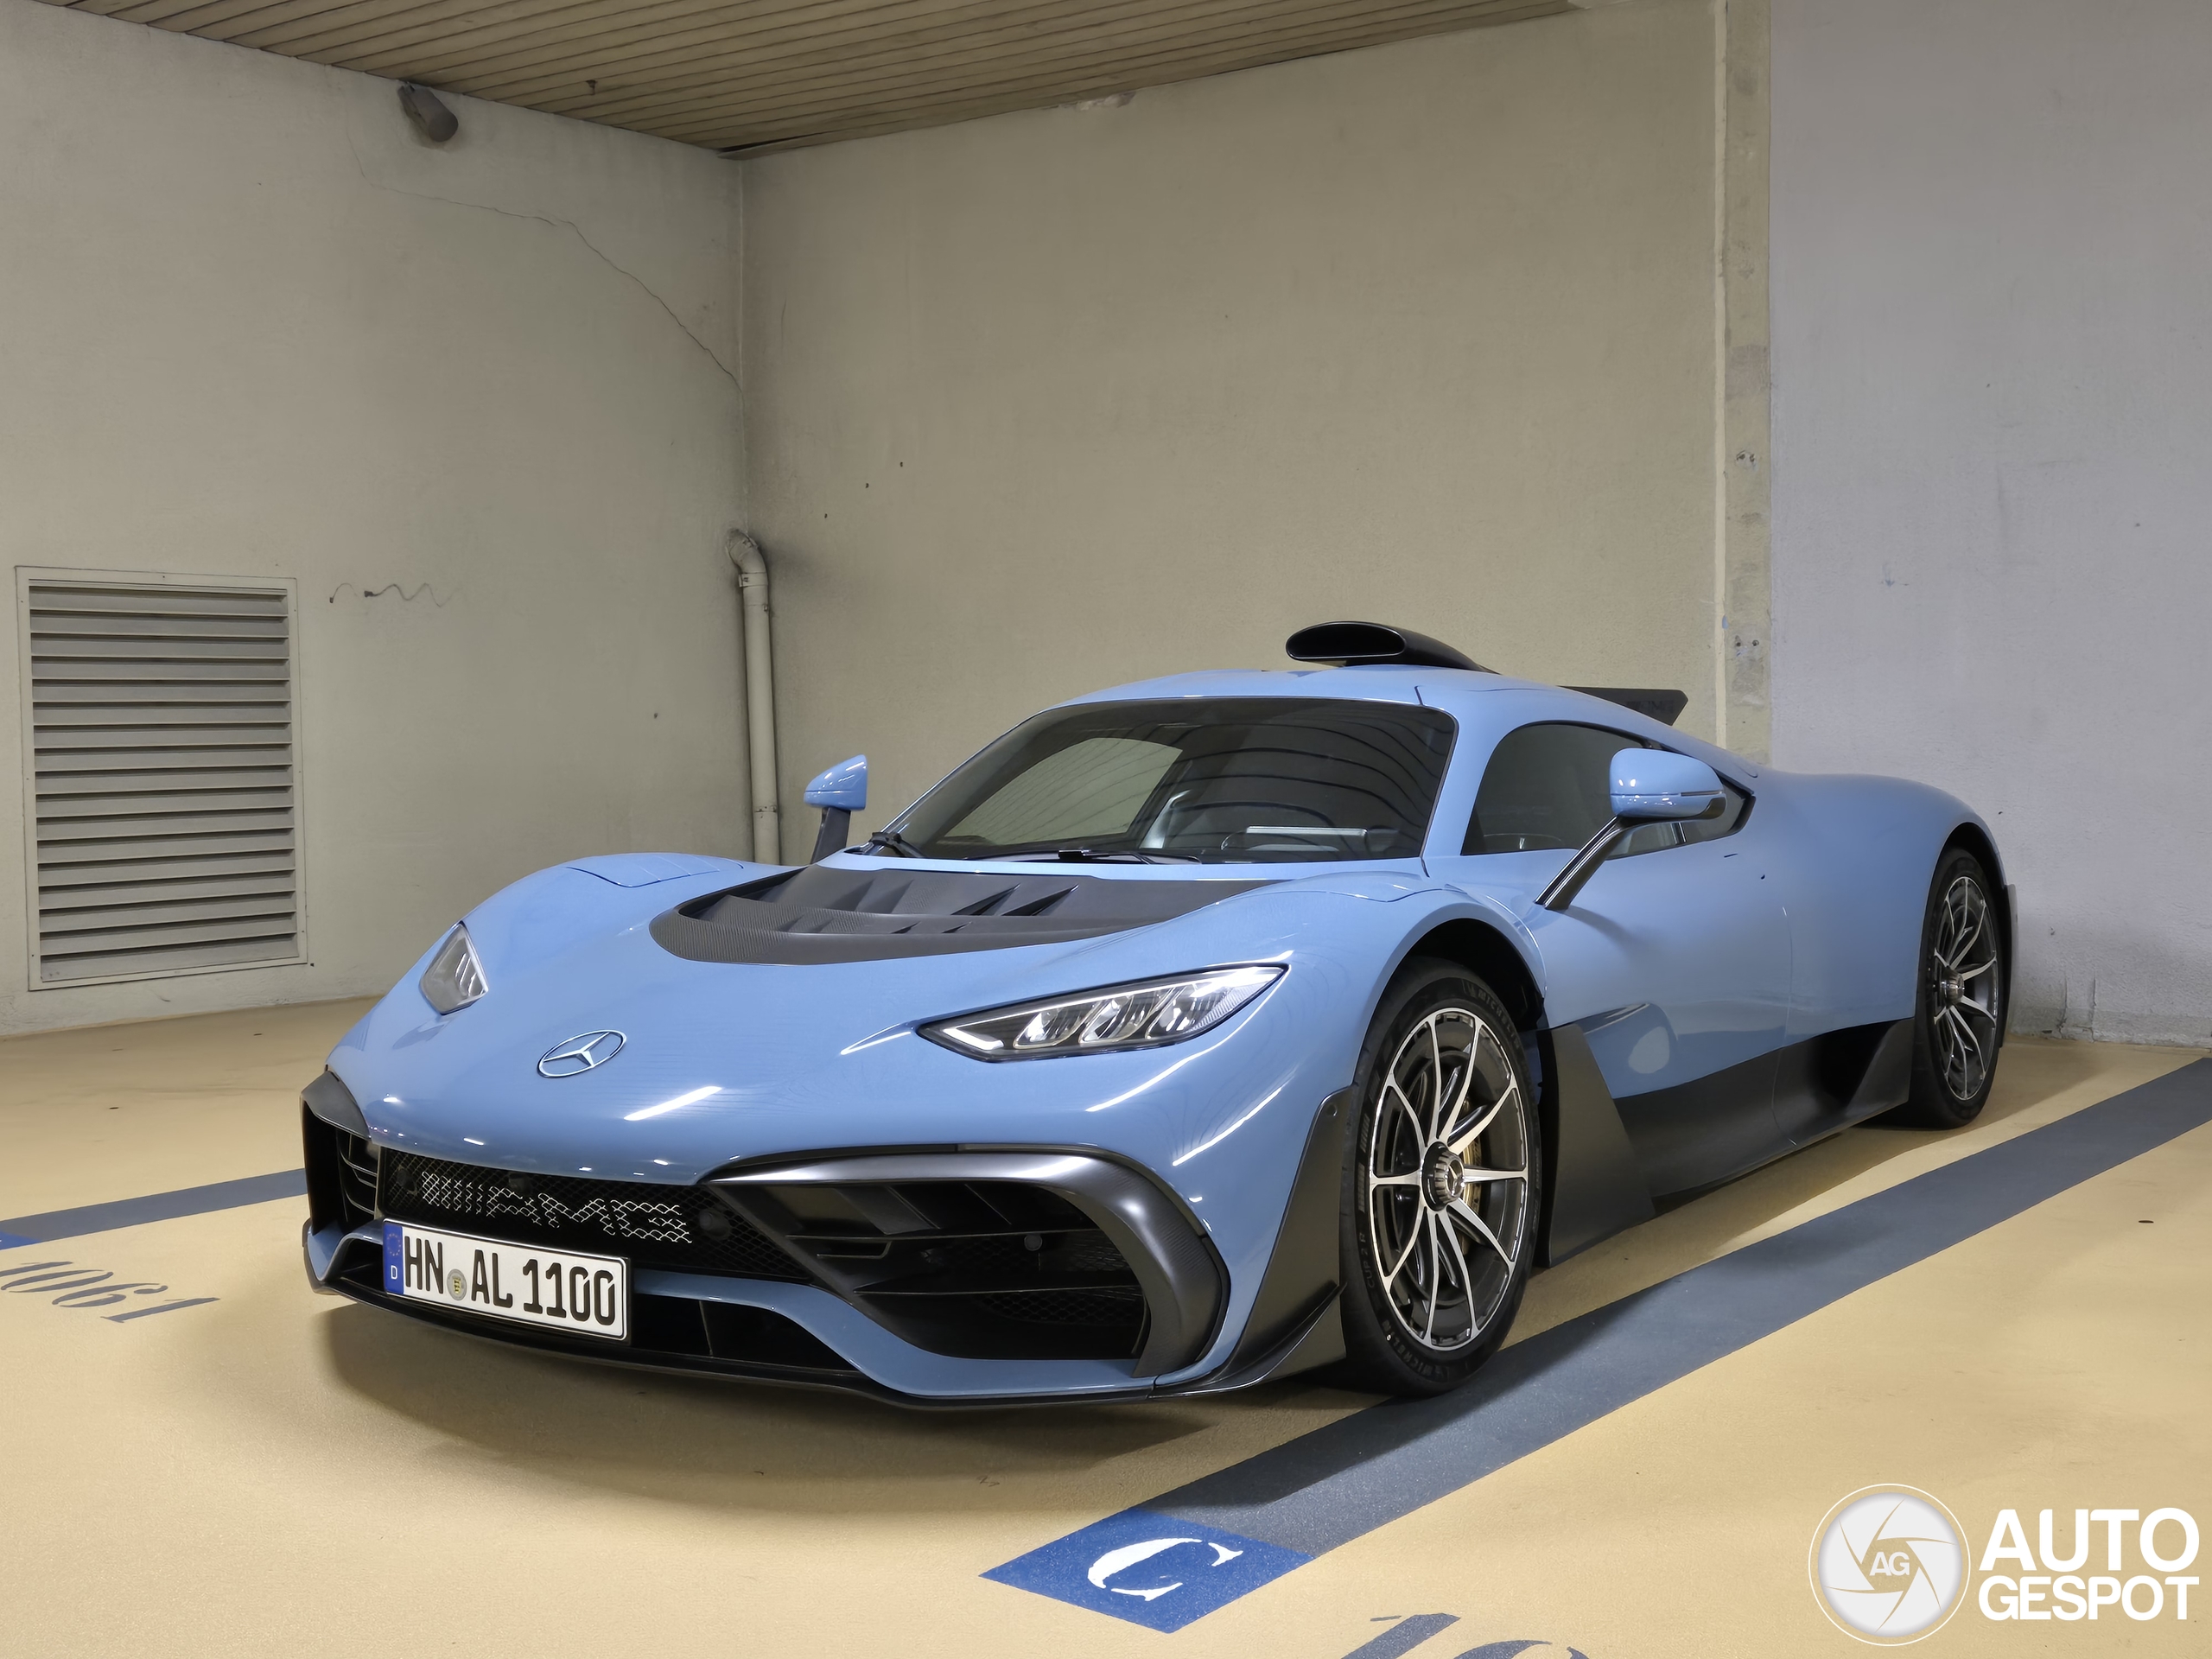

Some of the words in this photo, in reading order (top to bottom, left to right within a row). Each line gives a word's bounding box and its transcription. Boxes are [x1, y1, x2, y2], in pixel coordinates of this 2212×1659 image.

[1478, 988, 1521, 1050] MICHELIN
[486, 1186, 692, 1243] AMG
[1358, 1231, 1367, 1243] R
[391, 1265, 397, 1280] D
[404, 1236, 443, 1294] HN
[471, 1249, 513, 1308] AL
[523, 1259, 616, 1326] 1100
[1363, 1261, 1376, 1288] CUP
[1382, 1319, 1433, 1376] MICHELIN
[1086, 1537, 1244, 1601] C
